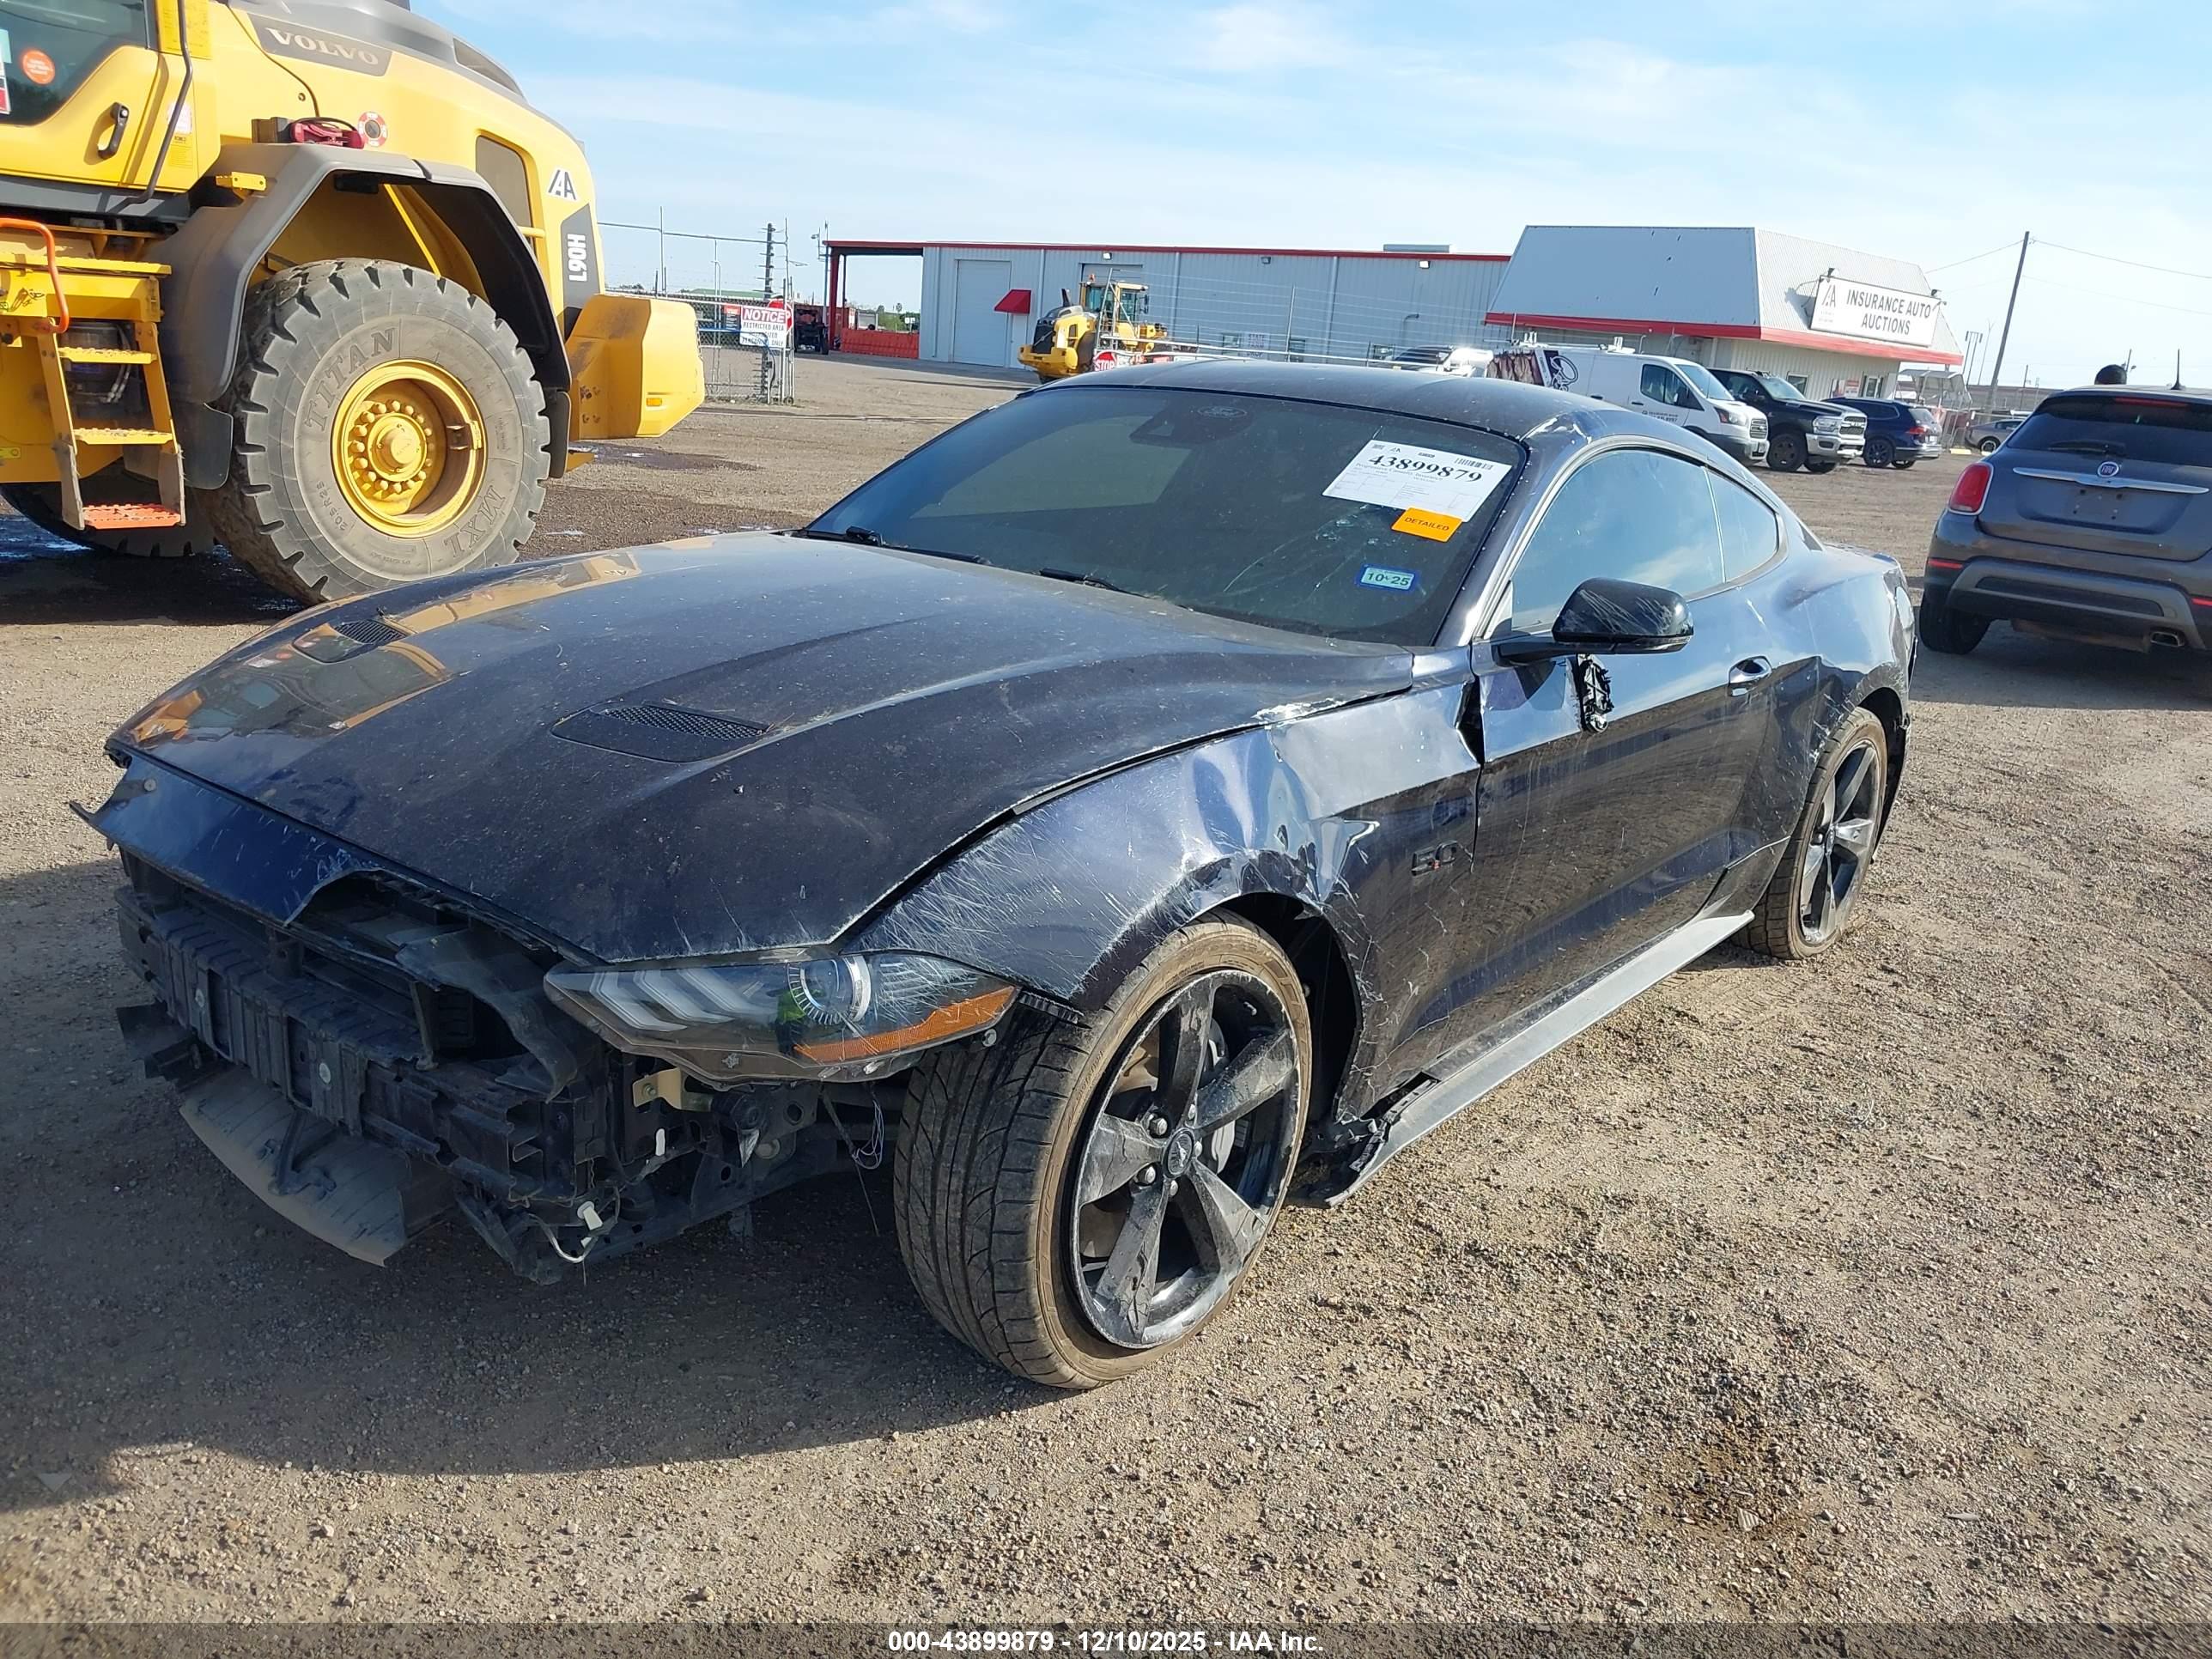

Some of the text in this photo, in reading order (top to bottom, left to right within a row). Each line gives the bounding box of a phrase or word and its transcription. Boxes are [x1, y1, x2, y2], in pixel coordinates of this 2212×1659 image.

[265, 27, 379, 65] VOLVO
[567, 234, 587, 283] L90H
[744, 308, 785, 323] NOTICE
[1846, 289, 1931, 319] INSURANCE AUTO
[1862, 313, 1911, 335] AUCTIONS
[306, 328, 396, 431] TITAN
[1095, 360, 1115, 371] STOP
[1368, 454, 1483, 483] 43899879
[1404, 517, 1450, 532] DETAILED
